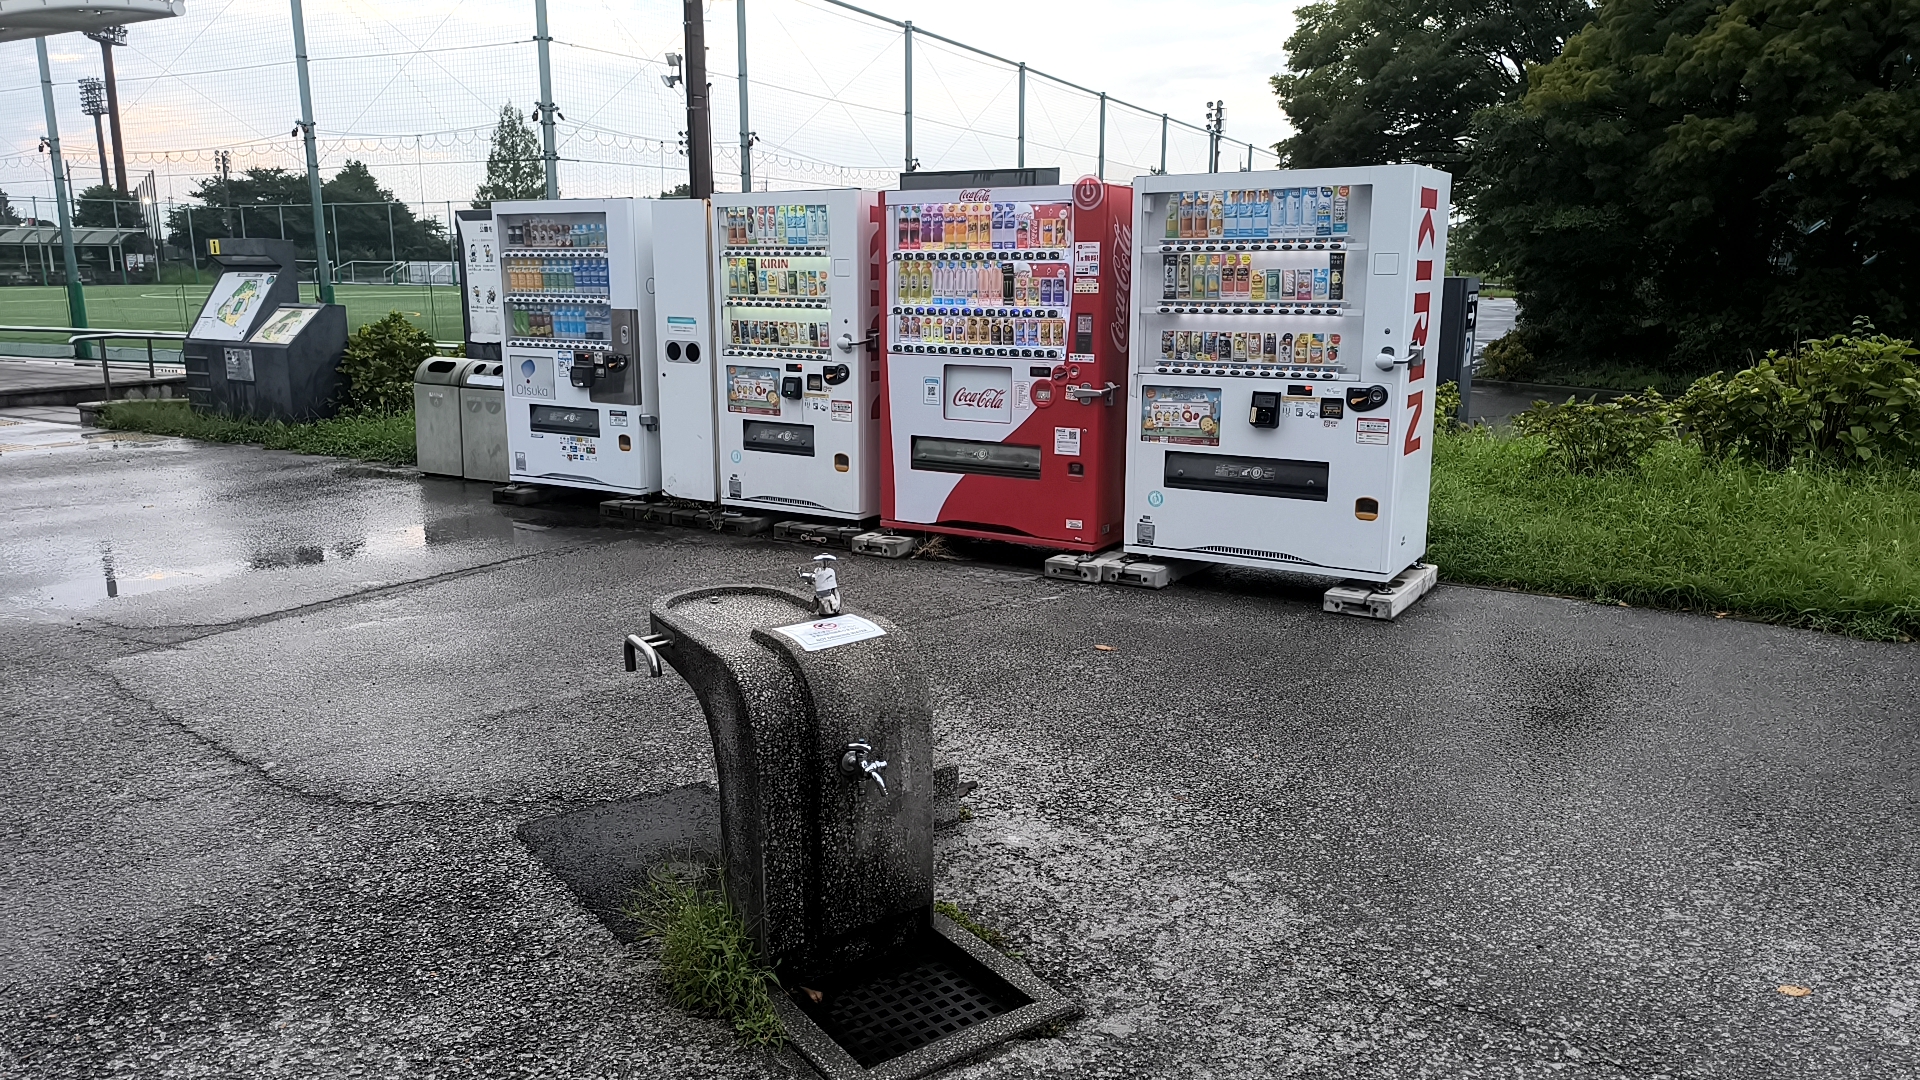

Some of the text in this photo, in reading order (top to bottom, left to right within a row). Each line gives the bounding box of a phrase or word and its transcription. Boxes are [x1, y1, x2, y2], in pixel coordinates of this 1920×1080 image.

[760, 258, 789, 269] KIRIN
[1404, 187, 1438, 456] KIRIN
[516, 384, 548, 397] Otsuka
